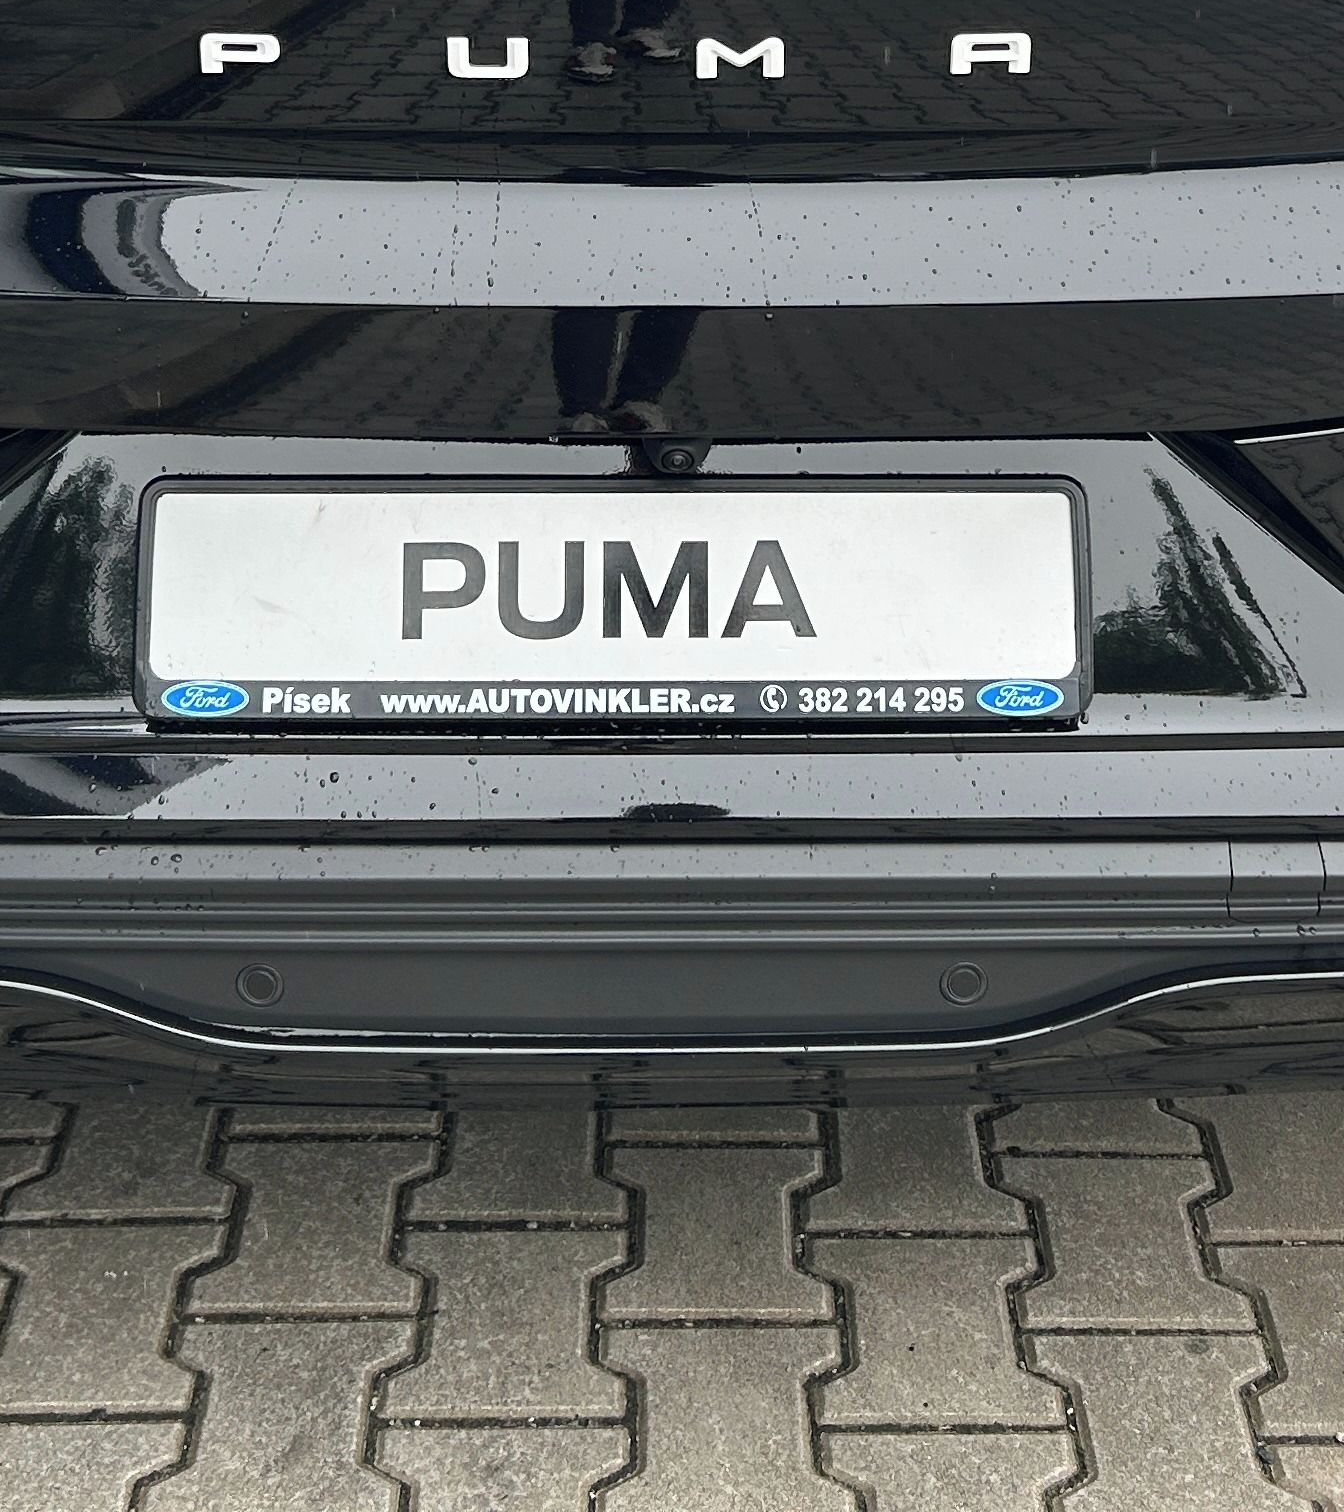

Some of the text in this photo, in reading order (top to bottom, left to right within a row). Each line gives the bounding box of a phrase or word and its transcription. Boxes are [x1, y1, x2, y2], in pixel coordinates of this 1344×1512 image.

[198, 32, 1033, 81] PUMA
[401, 540, 817, 640] PUMA
[262, 686, 351, 714] Písek
[380, 687, 736, 714] www.AUTOVINKLER.cz
[798, 686, 849, 714] 382
[856, 686, 907, 713] 214
[913, 686, 965, 713] 295
